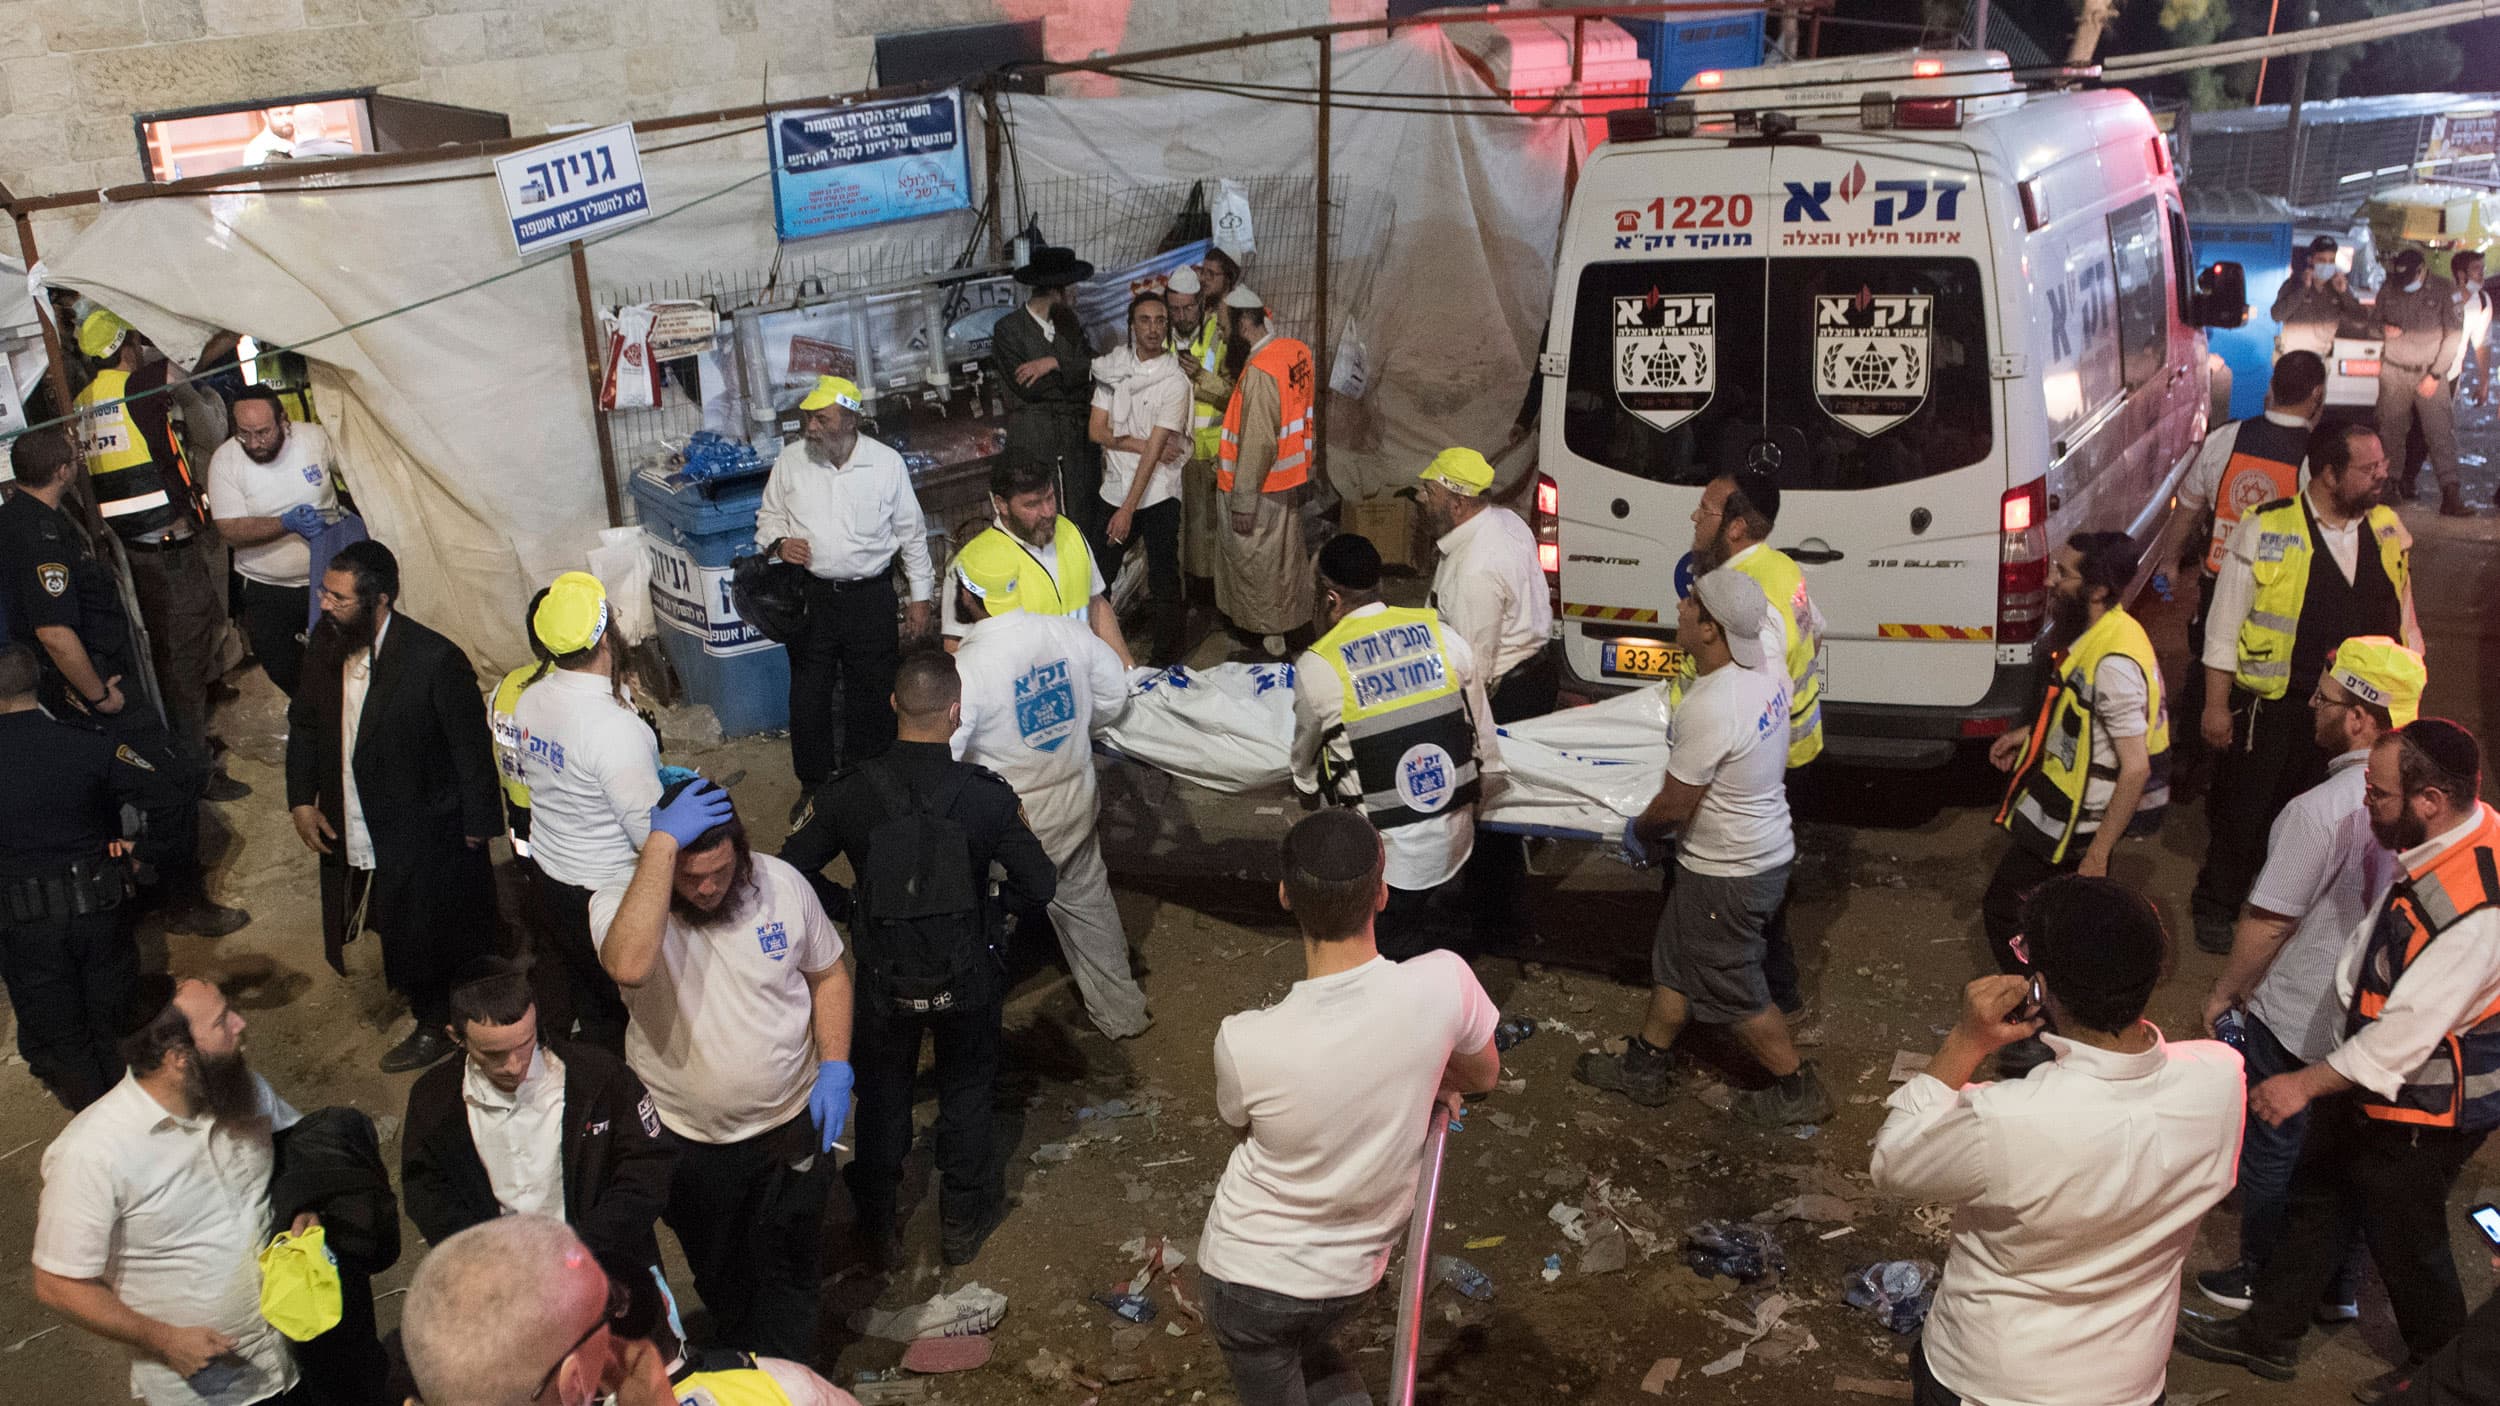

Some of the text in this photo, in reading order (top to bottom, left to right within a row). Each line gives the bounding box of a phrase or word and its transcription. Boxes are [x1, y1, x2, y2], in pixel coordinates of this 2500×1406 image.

[804, 116, 845, 133] והחמה
[848, 110, 886, 127] הקרה
[831, 127, 860, 144] הקל
[892, 135, 910, 149] על
[911, 131, 953, 148] מוגשים
[830, 143, 864, 161] לקהל
[865, 140, 891, 156] ידינו
[526, 145, 616, 198] גניזה
[519, 190, 642, 239] לא להשליך כאן אשפה
[1647, 194, 1753, 230] 1220
[1684, 233, 1753, 250] מוקד
[1783, 229, 1961, 247] איתור חילוץ והצלה
[1617, 325, 1711, 337] איתור חילוץ והצלה
[1820, 326, 1927, 337] איתור חילוץ והצלה
[649, 545, 691, 593] גניזה
[711, 628, 740, 643] אשפ
[1342, 637, 1382, 665] זק"א
